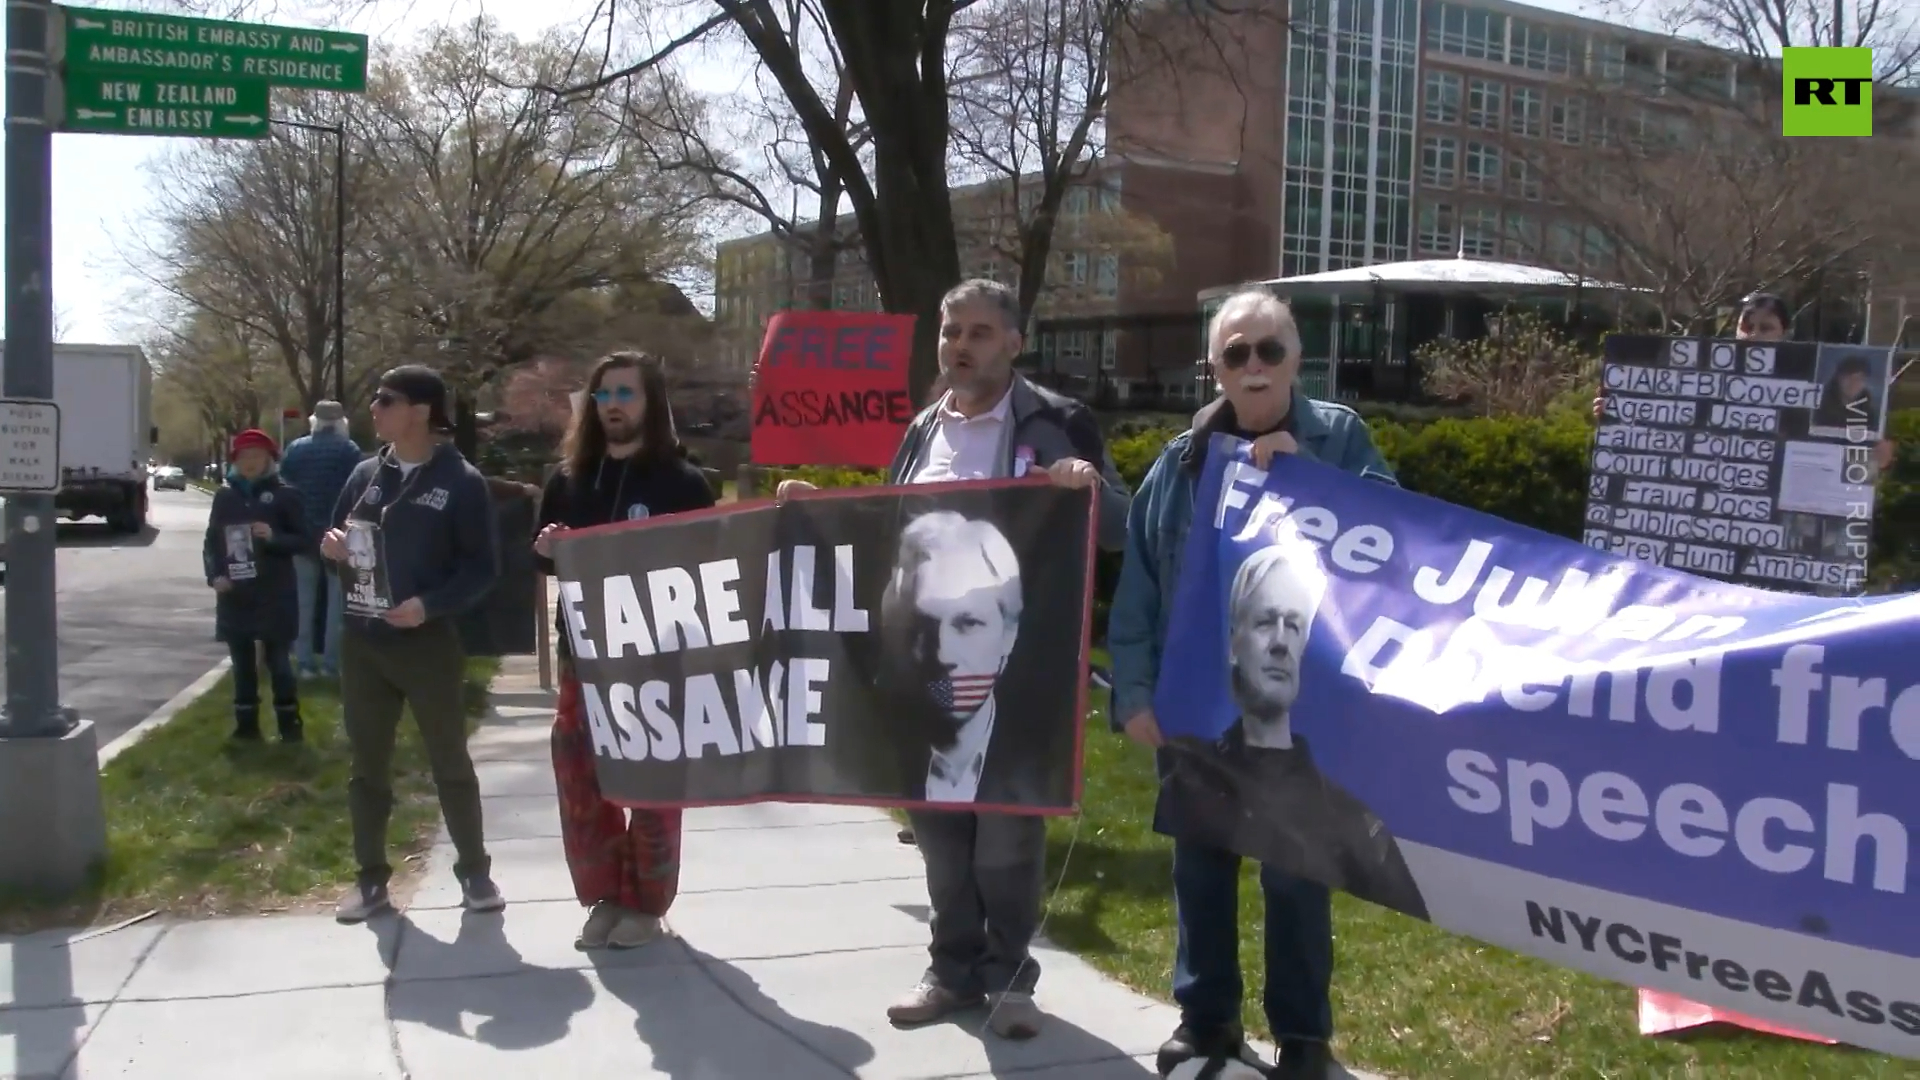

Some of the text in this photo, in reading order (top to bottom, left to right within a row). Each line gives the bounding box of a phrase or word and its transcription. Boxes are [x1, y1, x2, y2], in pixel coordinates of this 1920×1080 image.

[111, 19, 324, 53] BRITISH EMBASSY AND
[89, 44, 343, 81] AMBASSADOR'S RESIDENCE
[102, 82, 236, 105] NEW ZEALAND
[127, 108, 213, 129] EMBASSY
[771, 327, 896, 371] FREE
[755, 389, 911, 427] ASSANGE
[1727, 377, 1821, 408] Covert
[1604, 393, 1777, 432] Agents Used
[1693, 434, 1774, 460] Police
[1594, 451, 1667, 476] Court
[1671, 458, 1769, 490] Judges
[1214, 460, 1394, 573] Free
[1702, 489, 1771, 519] Docs
[603, 558, 750, 658] ARE
[761, 544, 869, 637] ALL
[1446, 748, 1908, 893] speech
